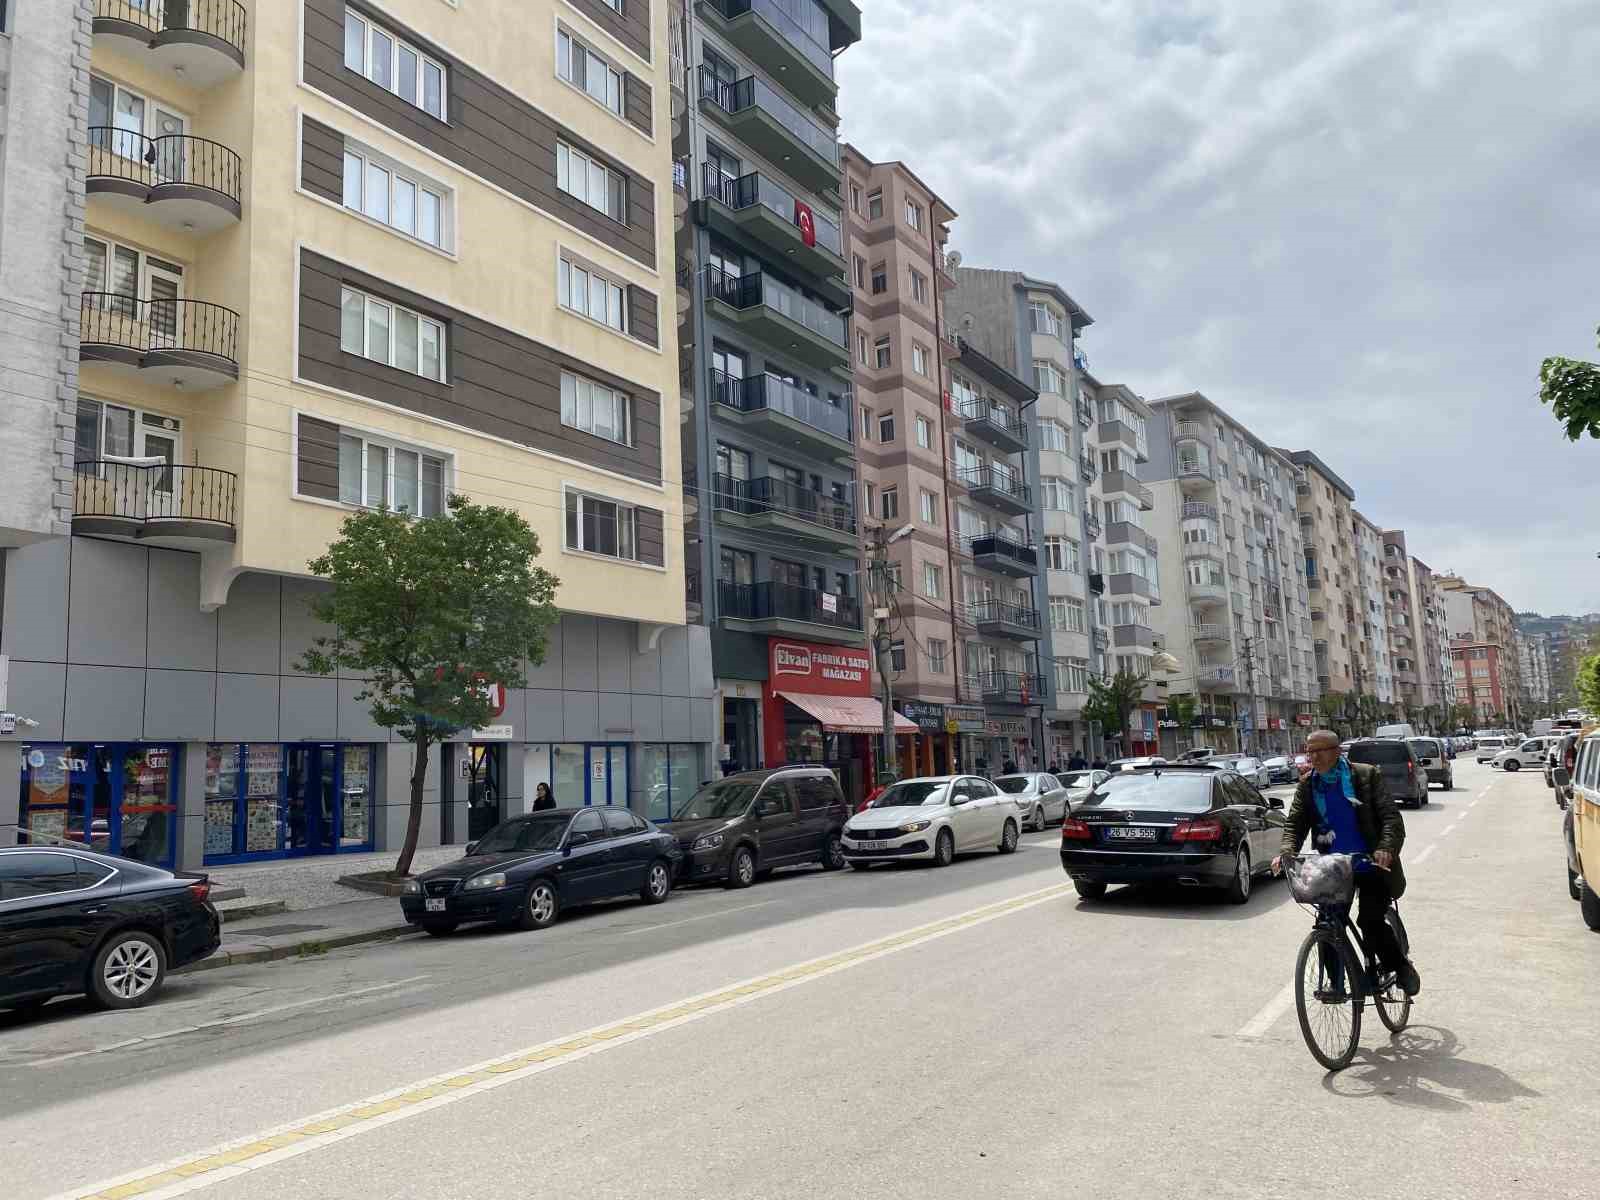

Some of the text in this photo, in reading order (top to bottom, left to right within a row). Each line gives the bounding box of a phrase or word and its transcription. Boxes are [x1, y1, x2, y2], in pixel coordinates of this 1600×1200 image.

[777, 649, 809, 667] Elvan
[1111, 828, 1121, 837] 26
[1125, 828, 1136, 837] VS
